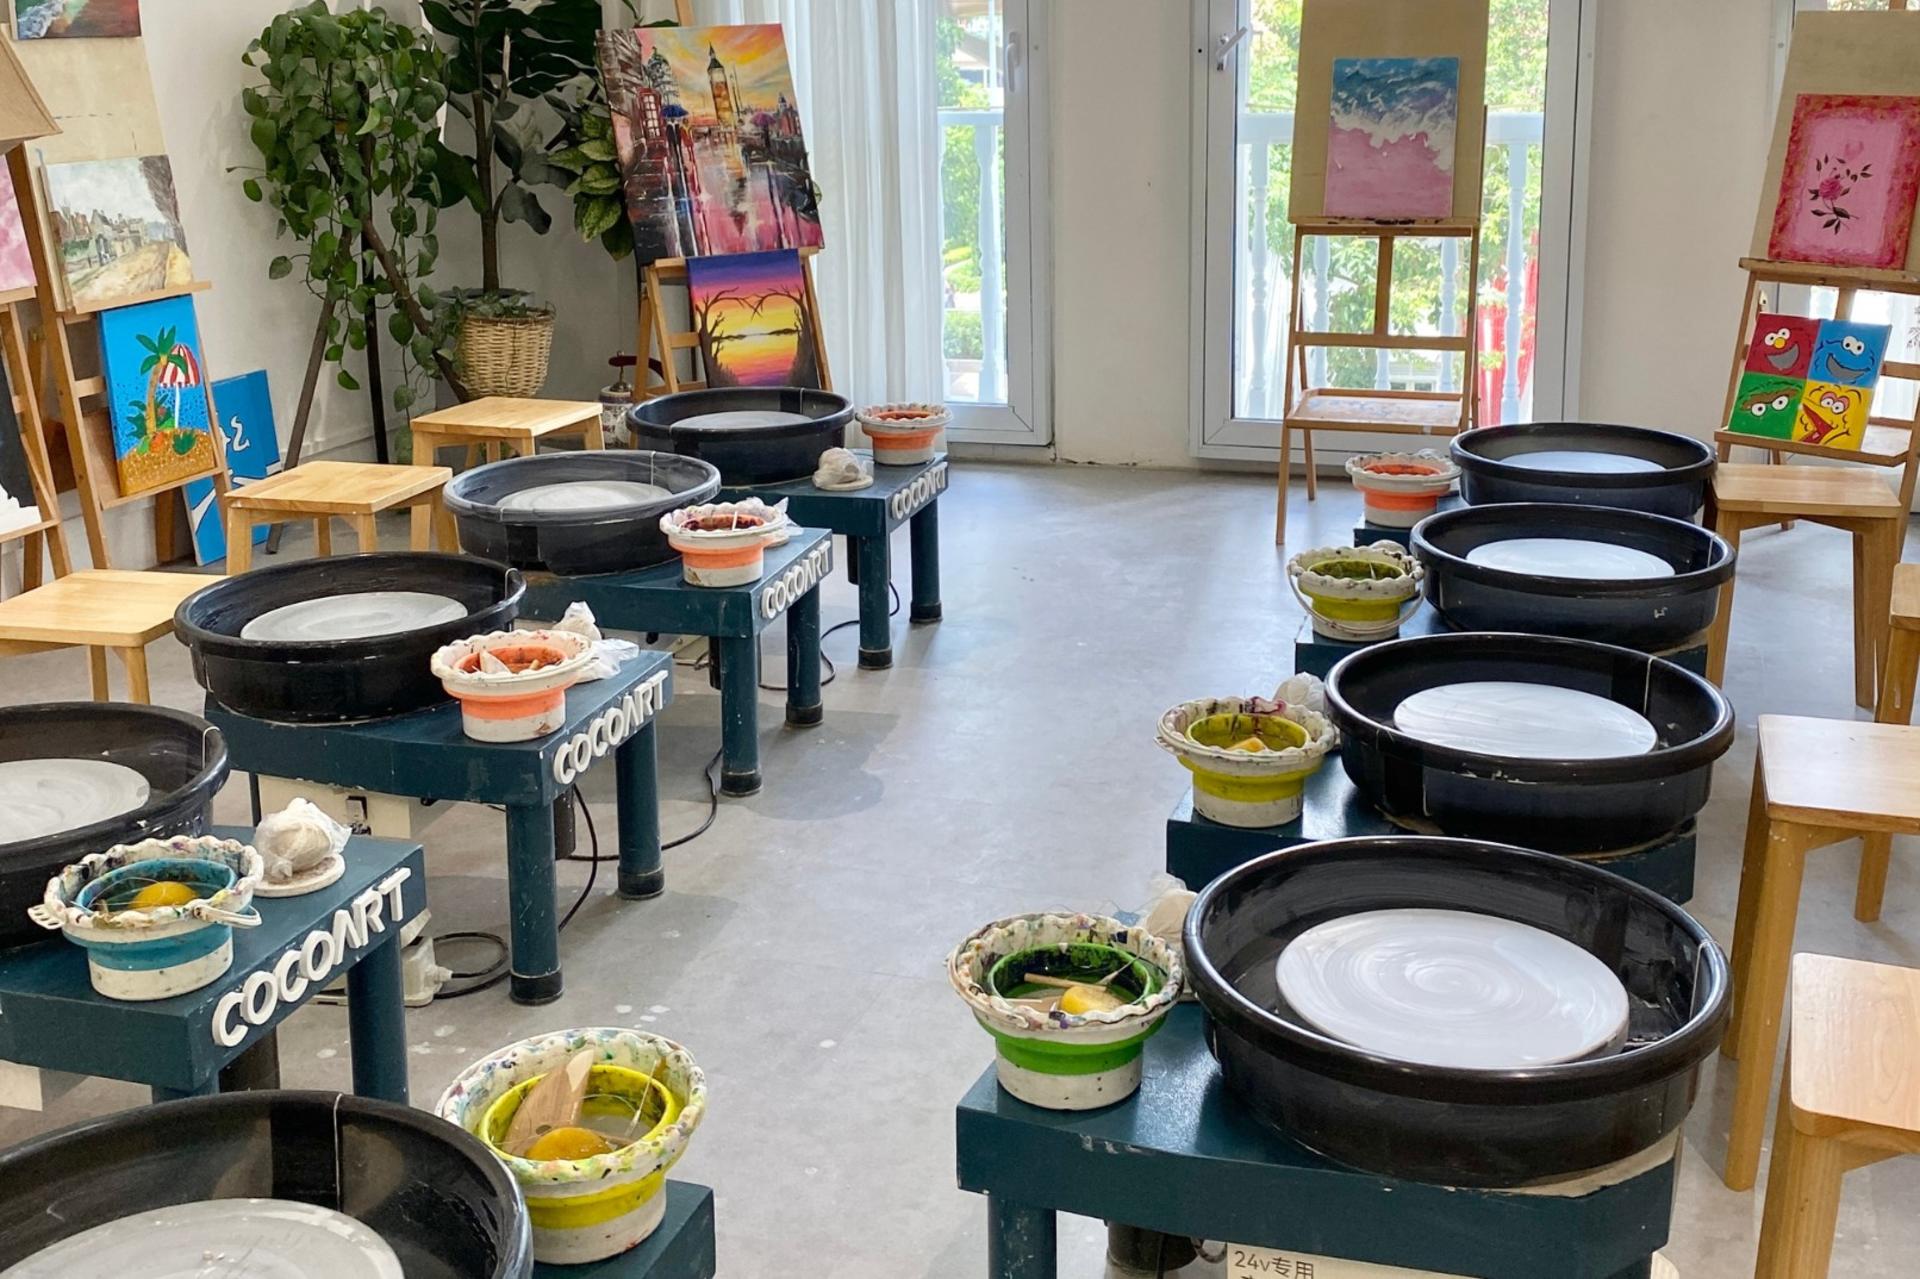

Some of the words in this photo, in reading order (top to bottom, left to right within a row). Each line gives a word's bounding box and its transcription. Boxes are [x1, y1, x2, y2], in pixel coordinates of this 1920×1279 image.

[891, 461, 948, 520] COCOART
[761, 540, 832, 620] COCOART
[553, 670, 669, 785] COCOART
[212, 867, 412, 1047] COCOART
